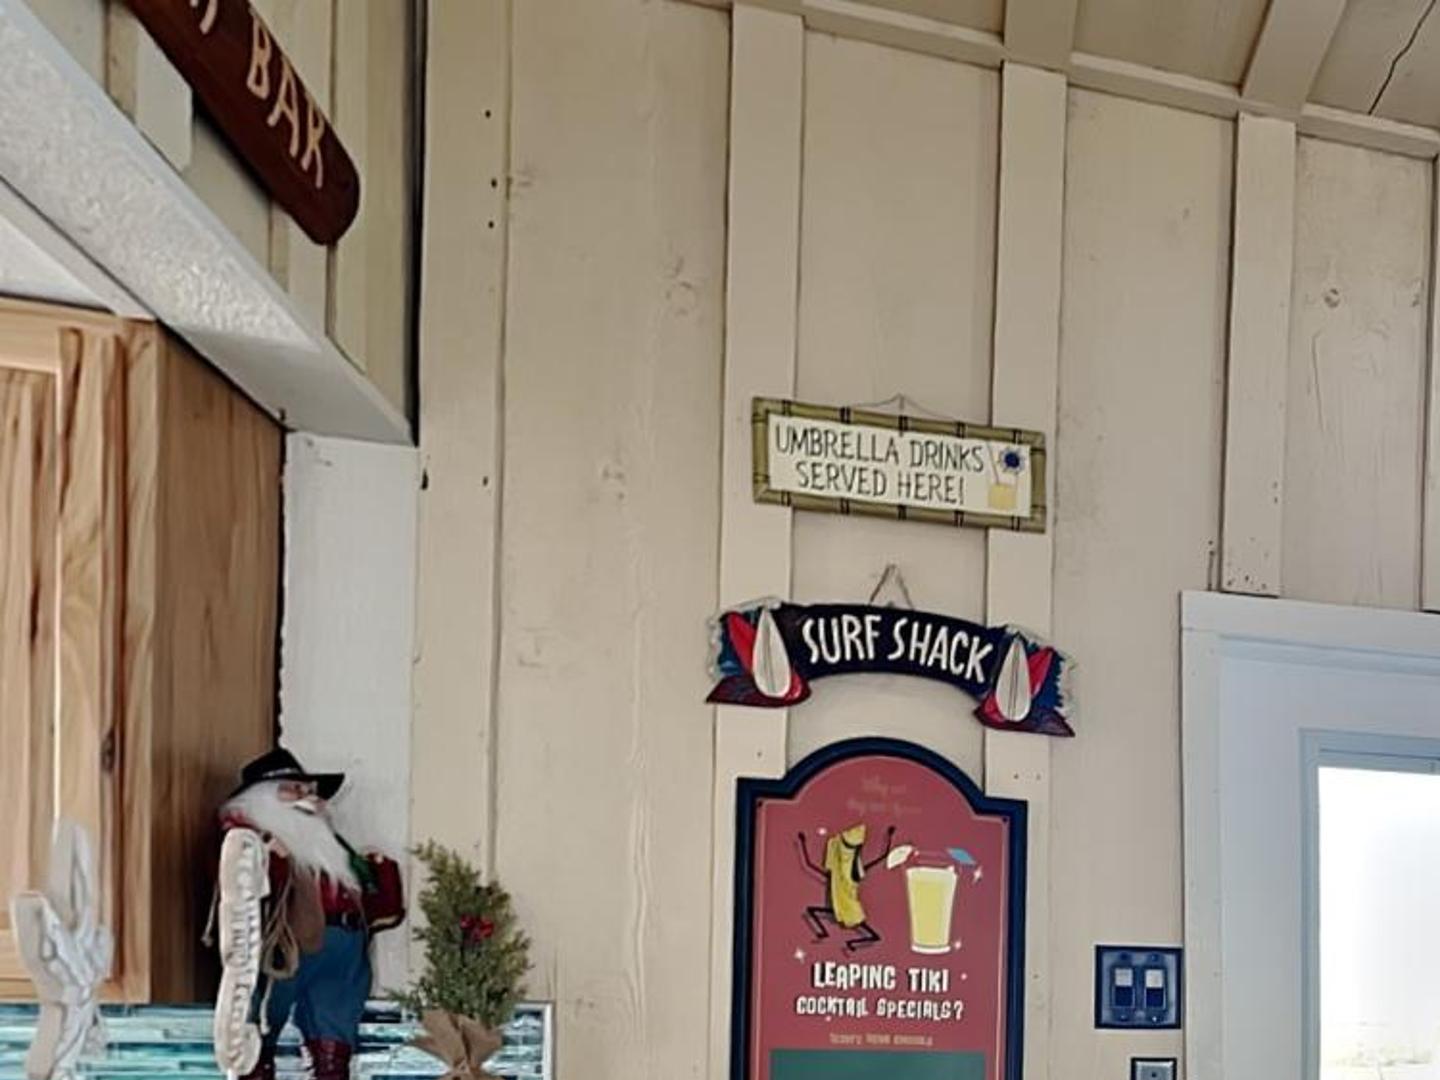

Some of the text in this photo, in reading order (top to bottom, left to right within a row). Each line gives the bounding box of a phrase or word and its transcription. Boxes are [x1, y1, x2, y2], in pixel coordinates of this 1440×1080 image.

[247, 13, 325, 189] BAR
[775, 424, 984, 473] UMBRELLA DRINKS
[795, 461, 964, 505] SERVED HERE!
[802, 614, 993, 683] SURF SHACK
[907, 967, 949, 993] TIKI
[796, 995, 964, 1021] COCKTAIL SPECIALS?
